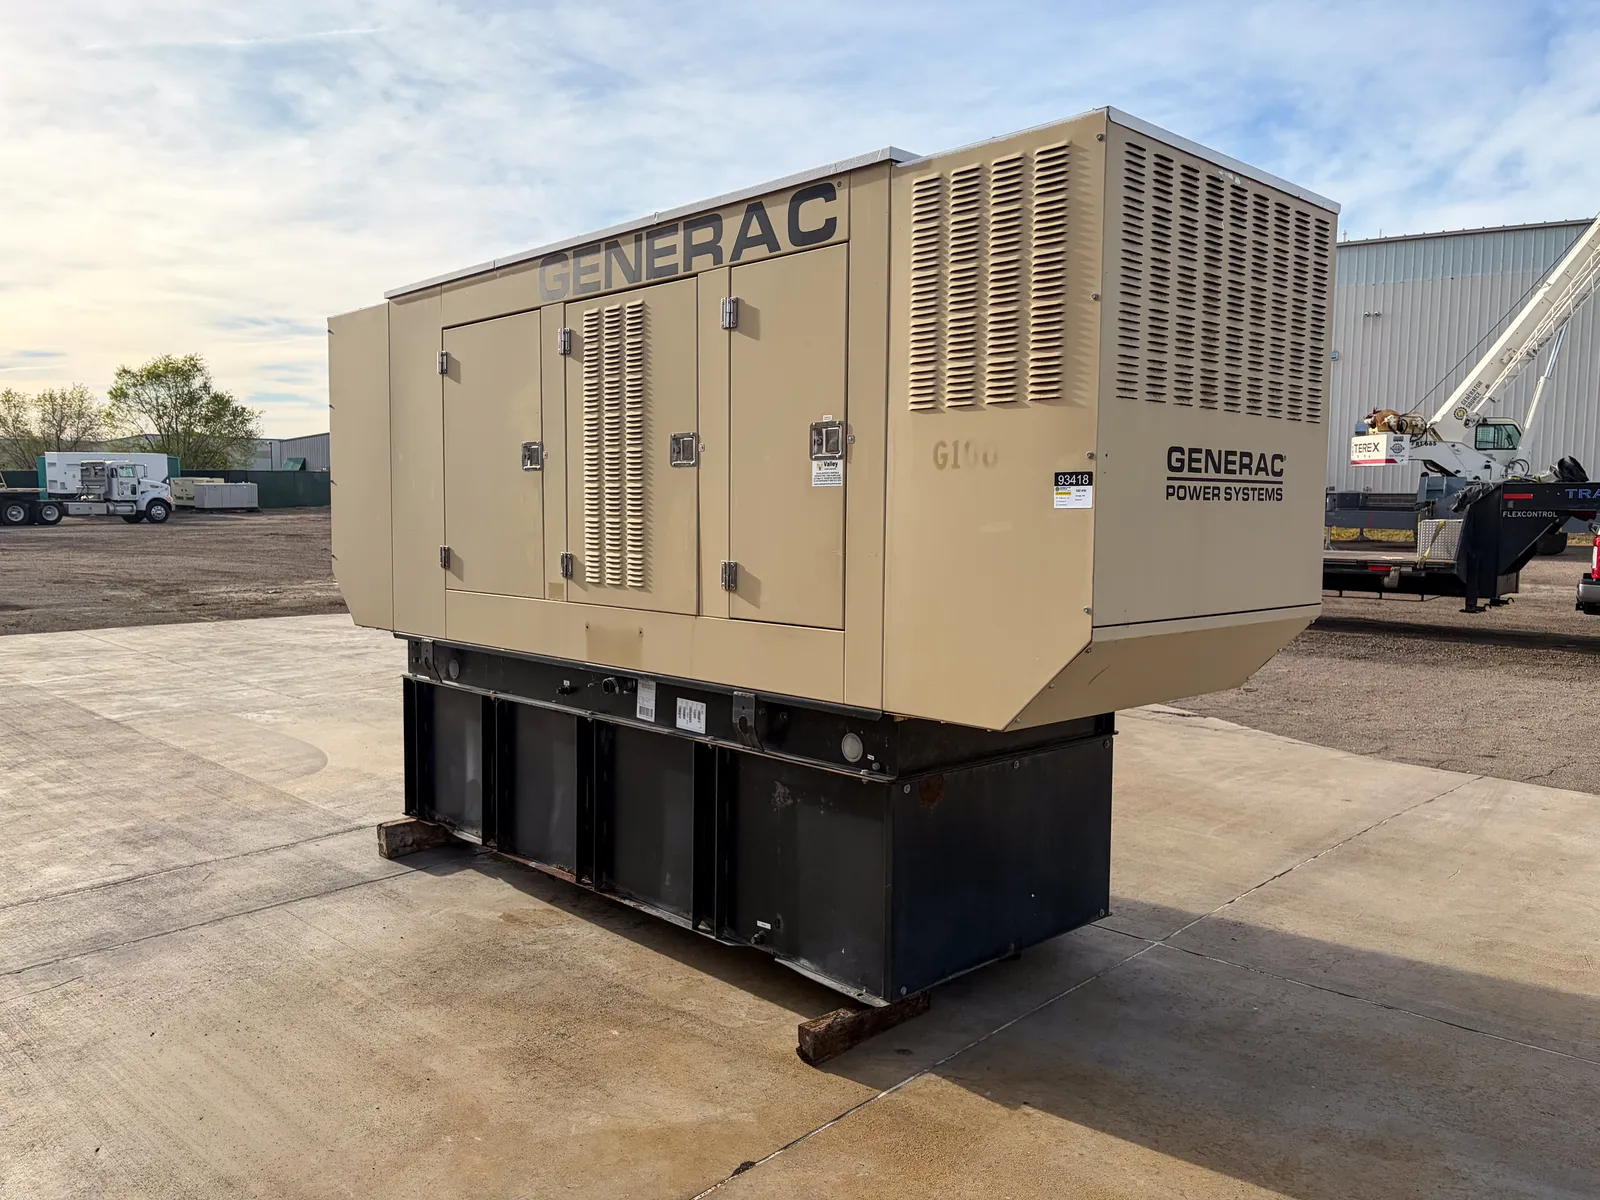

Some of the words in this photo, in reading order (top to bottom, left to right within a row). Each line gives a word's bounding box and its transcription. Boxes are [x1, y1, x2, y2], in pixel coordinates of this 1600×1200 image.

[539, 182, 837, 301] GENERAC
[1461, 380, 1483, 405] GENERATOR
[1465, 391, 1481, 409] SOURCE
[1354, 442, 1380, 453] TEREX
[1167, 446, 1284, 477] GENERAC
[1057, 474, 1089, 485] 93418
[1166, 485, 1220, 500] POWER
[1224, 486, 1283, 502] SYSTEMS
